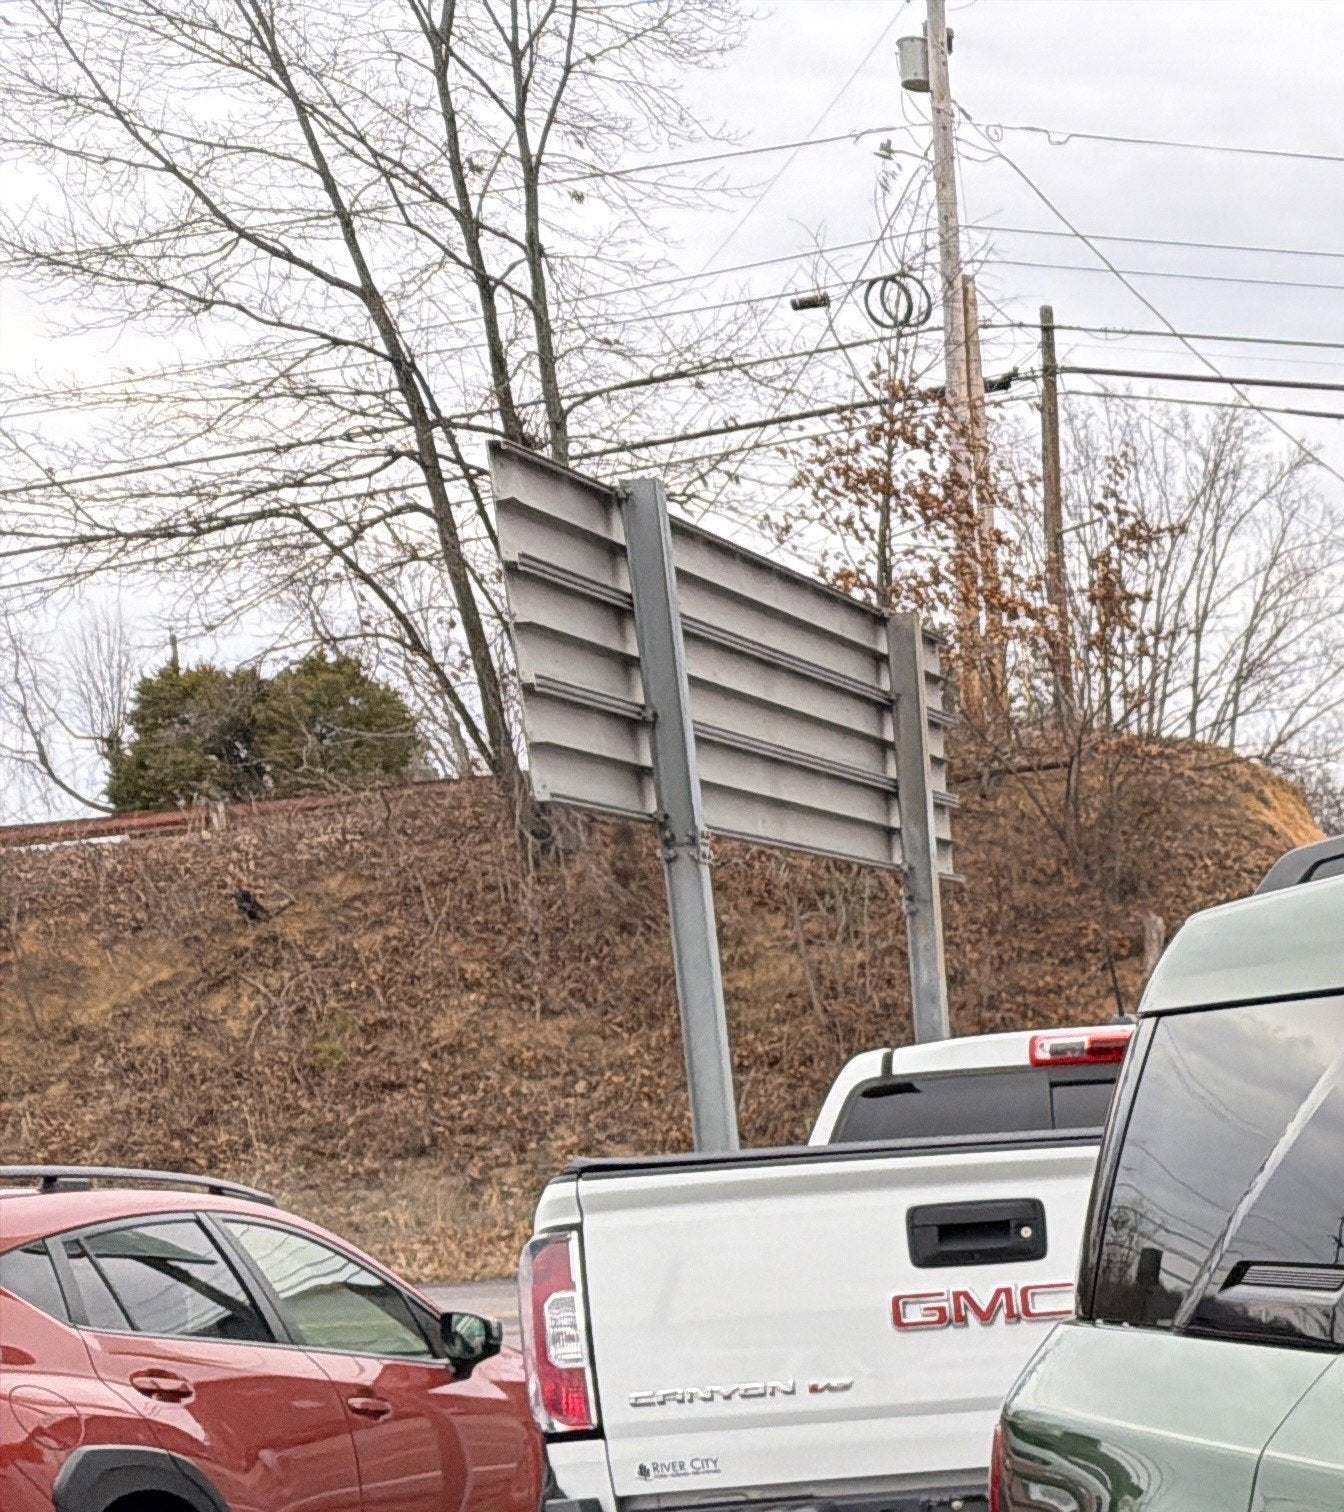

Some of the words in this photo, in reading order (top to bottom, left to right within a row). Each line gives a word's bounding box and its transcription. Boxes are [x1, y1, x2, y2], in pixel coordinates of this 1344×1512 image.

[890, 1280, 1075, 1331] GMC
[629, 1378, 796, 1408] CANYON
[652, 1461, 686, 1474] RIVER
[690, 1457, 719, 1471] CITY
